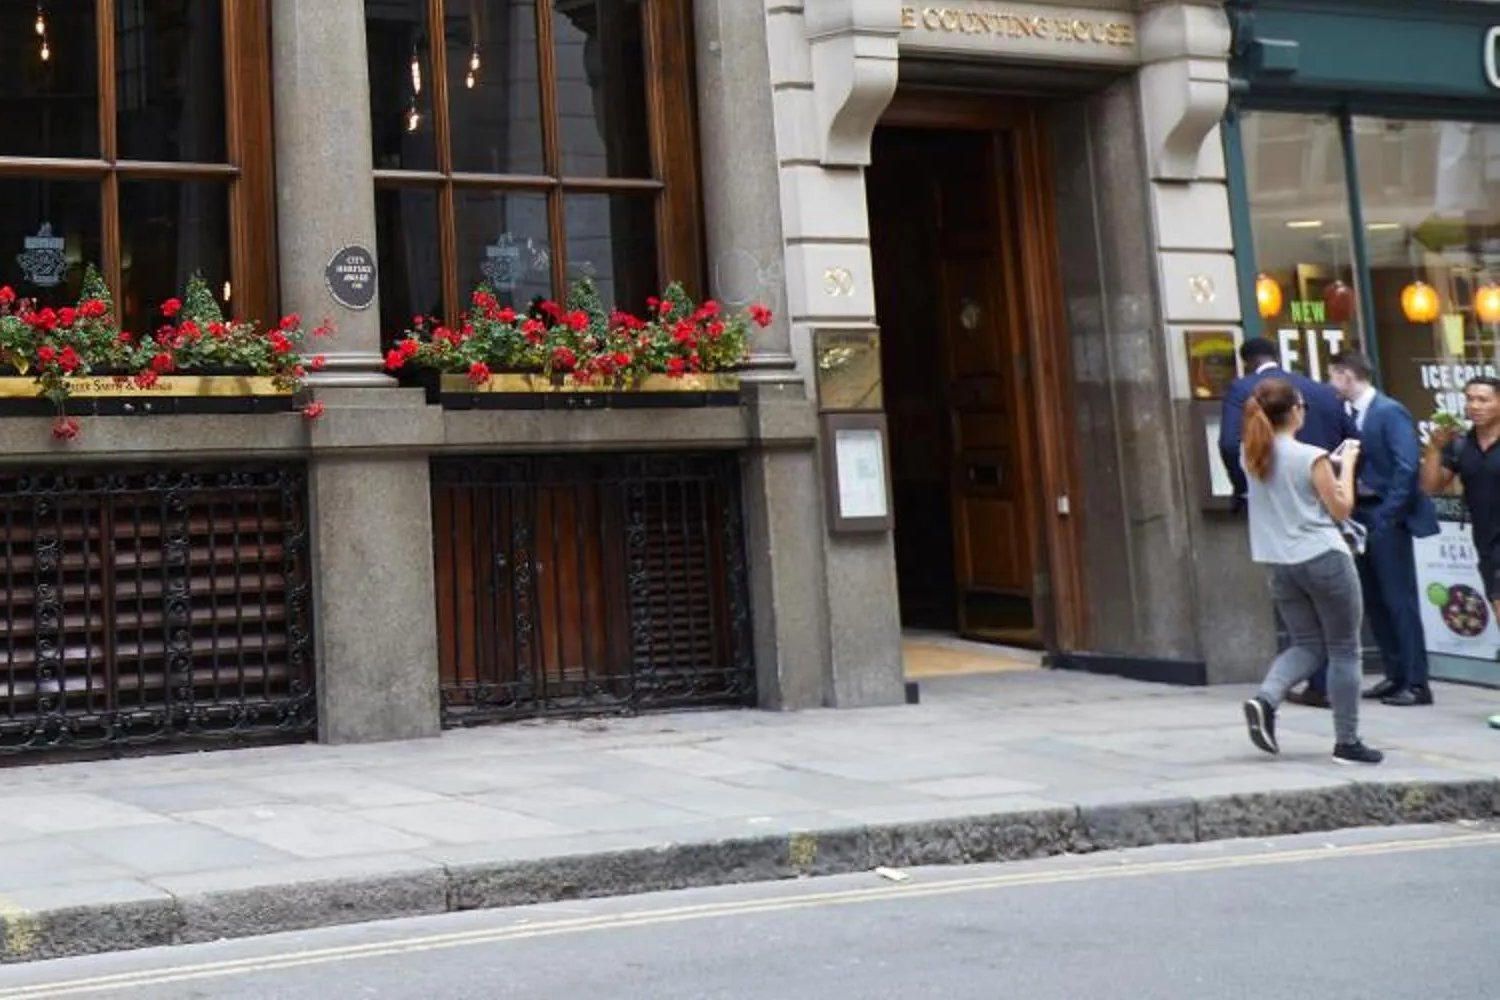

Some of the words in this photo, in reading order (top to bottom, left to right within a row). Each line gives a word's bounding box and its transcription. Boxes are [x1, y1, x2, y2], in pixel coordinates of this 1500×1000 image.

[922, 7, 1049, 39] COUNTING
[1052, 15, 1135, 47] HOUSE
[1290, 300, 1326, 324] NEW
[1421, 365, 1451, 389] ICE
